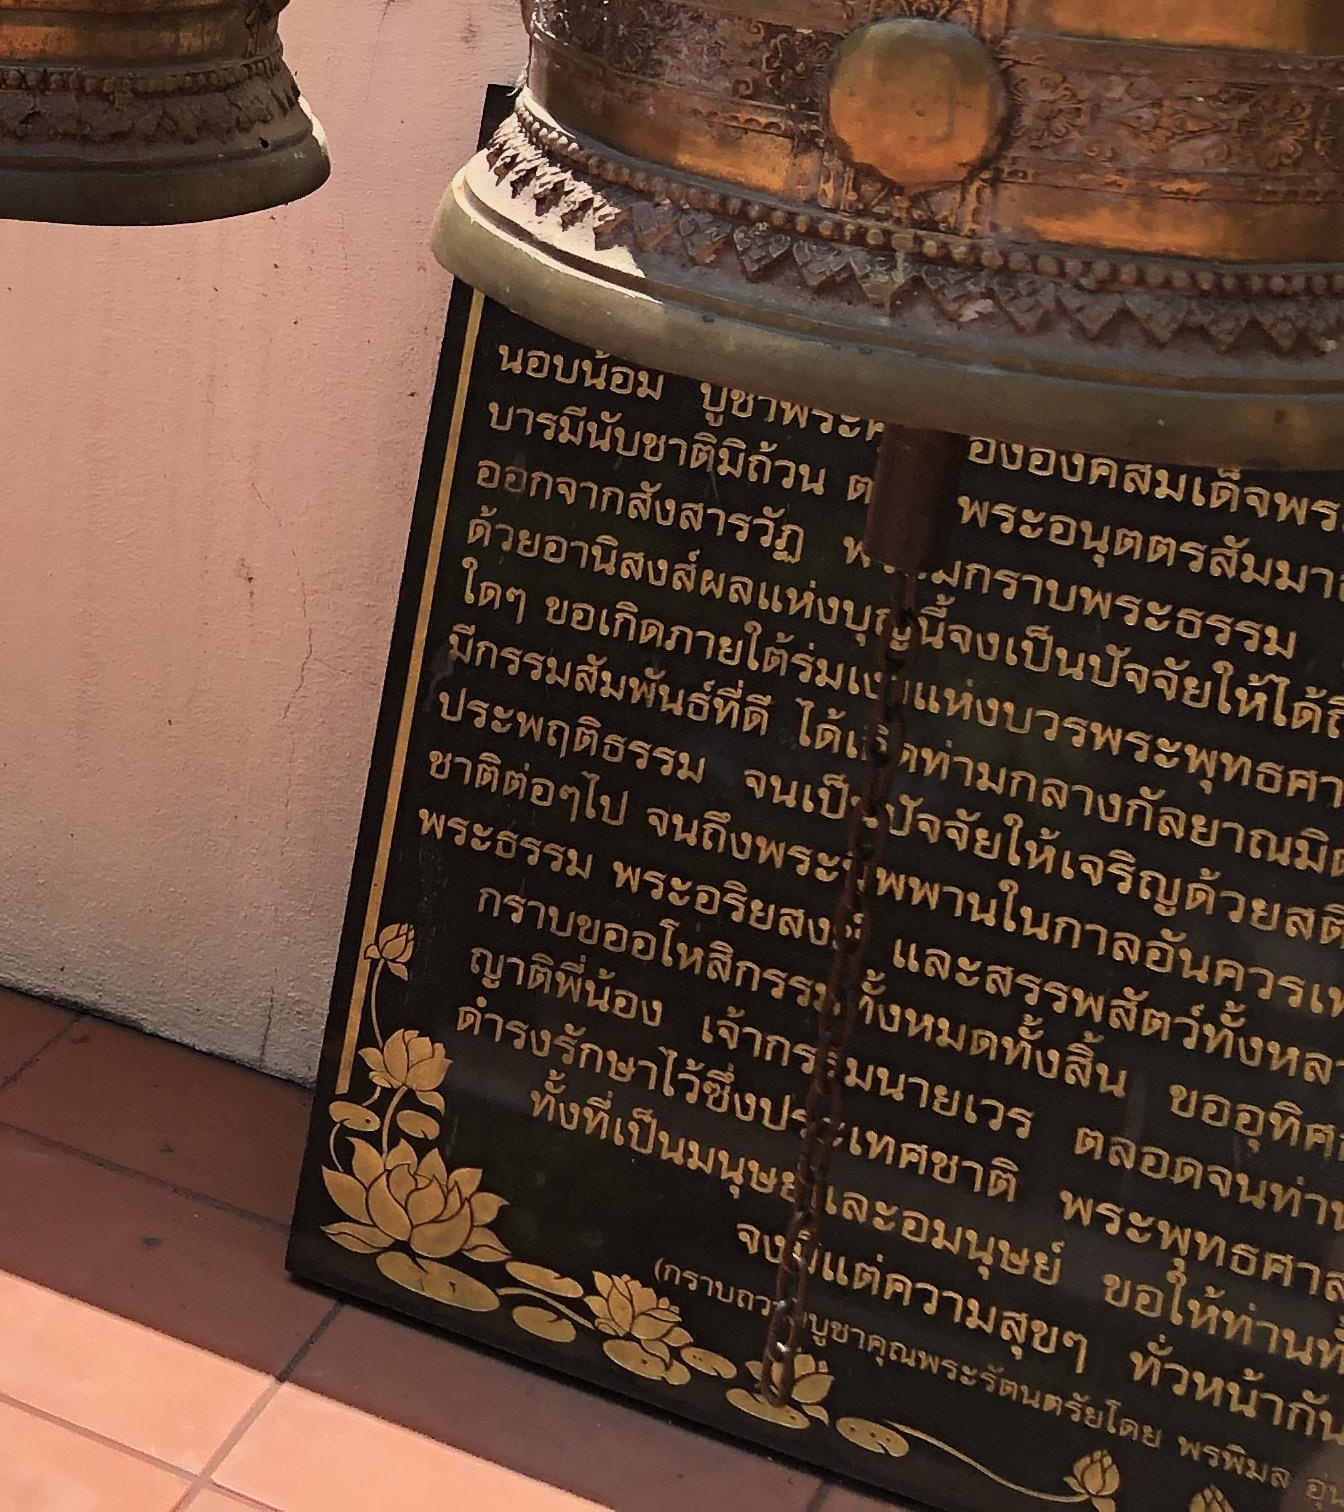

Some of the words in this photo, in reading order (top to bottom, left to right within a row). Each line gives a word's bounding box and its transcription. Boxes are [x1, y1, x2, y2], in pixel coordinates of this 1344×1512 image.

[497, 343, 664, 401] นอบน้อม
[488, 402, 826, 495] บารมีนับชาติมิถ้วน
[957, 494, 1344, 602] พระอนุตตรสัมมา
[461, 557, 526, 624] ใดๆ
[448, 623, 773, 736] มีกรรมสัมพันธ์ที่ดี
[438, 688, 706, 785] ประพฤติธรรม
[428, 750, 629, 827] ชาติต่อๆไป
[418, 807, 593, 880] พระธรรม
[470, 947, 662, 1029] ญาติพี่น้อง
[1168, 1083, 1344, 1160] ขออุทิศ
